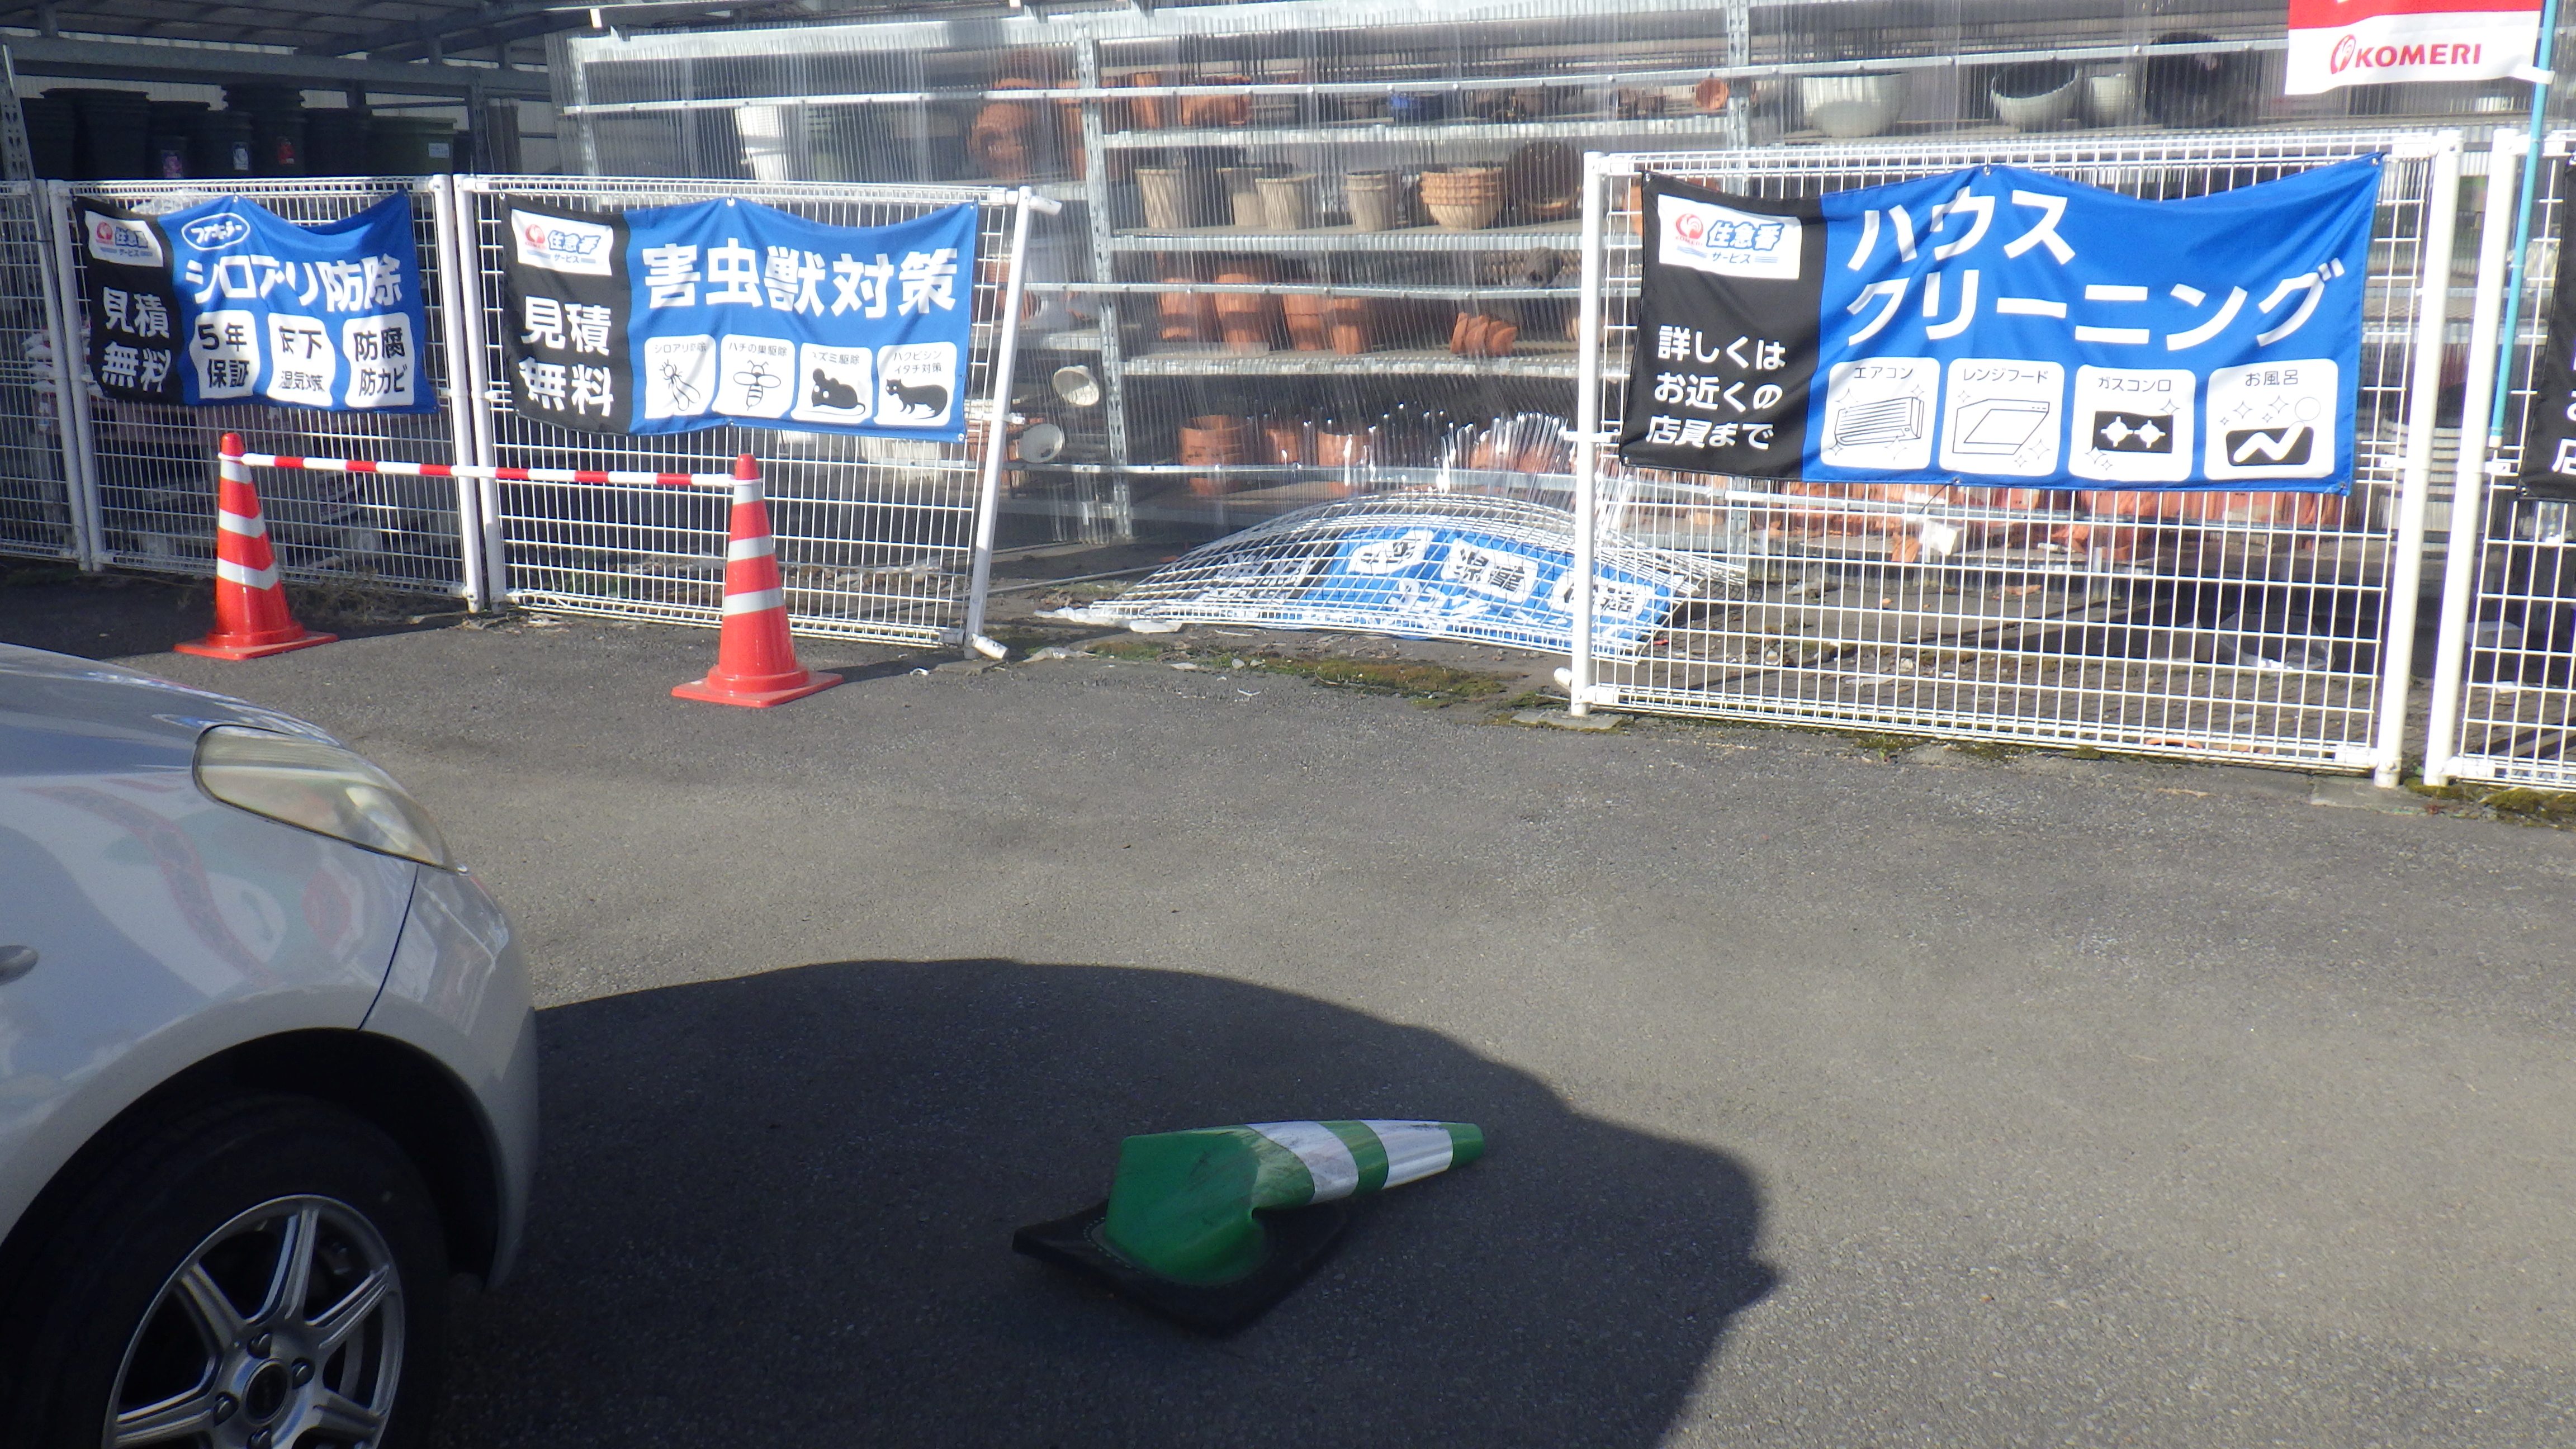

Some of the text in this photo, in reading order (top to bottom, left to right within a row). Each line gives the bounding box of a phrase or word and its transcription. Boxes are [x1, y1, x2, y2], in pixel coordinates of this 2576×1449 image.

[2355, 43, 2482, 68] KOMERI
[1706, 220, 1785, 252] 住急番
[1848, 186, 2076, 271] ハウス
[554, 253, 579, 263] サービス
[1712, 252, 1751, 264] サービス
[186, 253, 402, 312] シロアリ防除
[642, 238, 958, 318] 害虫獣対策
[103, 286, 170, 338] 見積
[1846, 257, 2345, 351] クリーニング
[198, 323, 247, 352] 5年
[520, 295, 612, 356] 見積
[353, 326, 406, 362] 防腐
[728, 342, 788, 357] ハチの巣駆除
[893, 351, 942, 362] ハクビシン
[1658, 325, 1786, 370] 詳しくは
[102, 340, 172, 392] 無料
[207, 359, 250, 388] 保証
[358, 364, 408, 396] 防カビ
[894, 362, 942, 374] イタチ対策
[1853, 366, 1914, 380] エアコン
[1963, 368, 2049, 385] レンジフード
[2244, 370, 2299, 387] お風呂
[518, 356, 614, 416] 無料
[1654, 372, 1783, 413] お近くの
[2097, 376, 2171, 392] ガスコンロ
[1645, 415, 1774, 450] 店員まで
